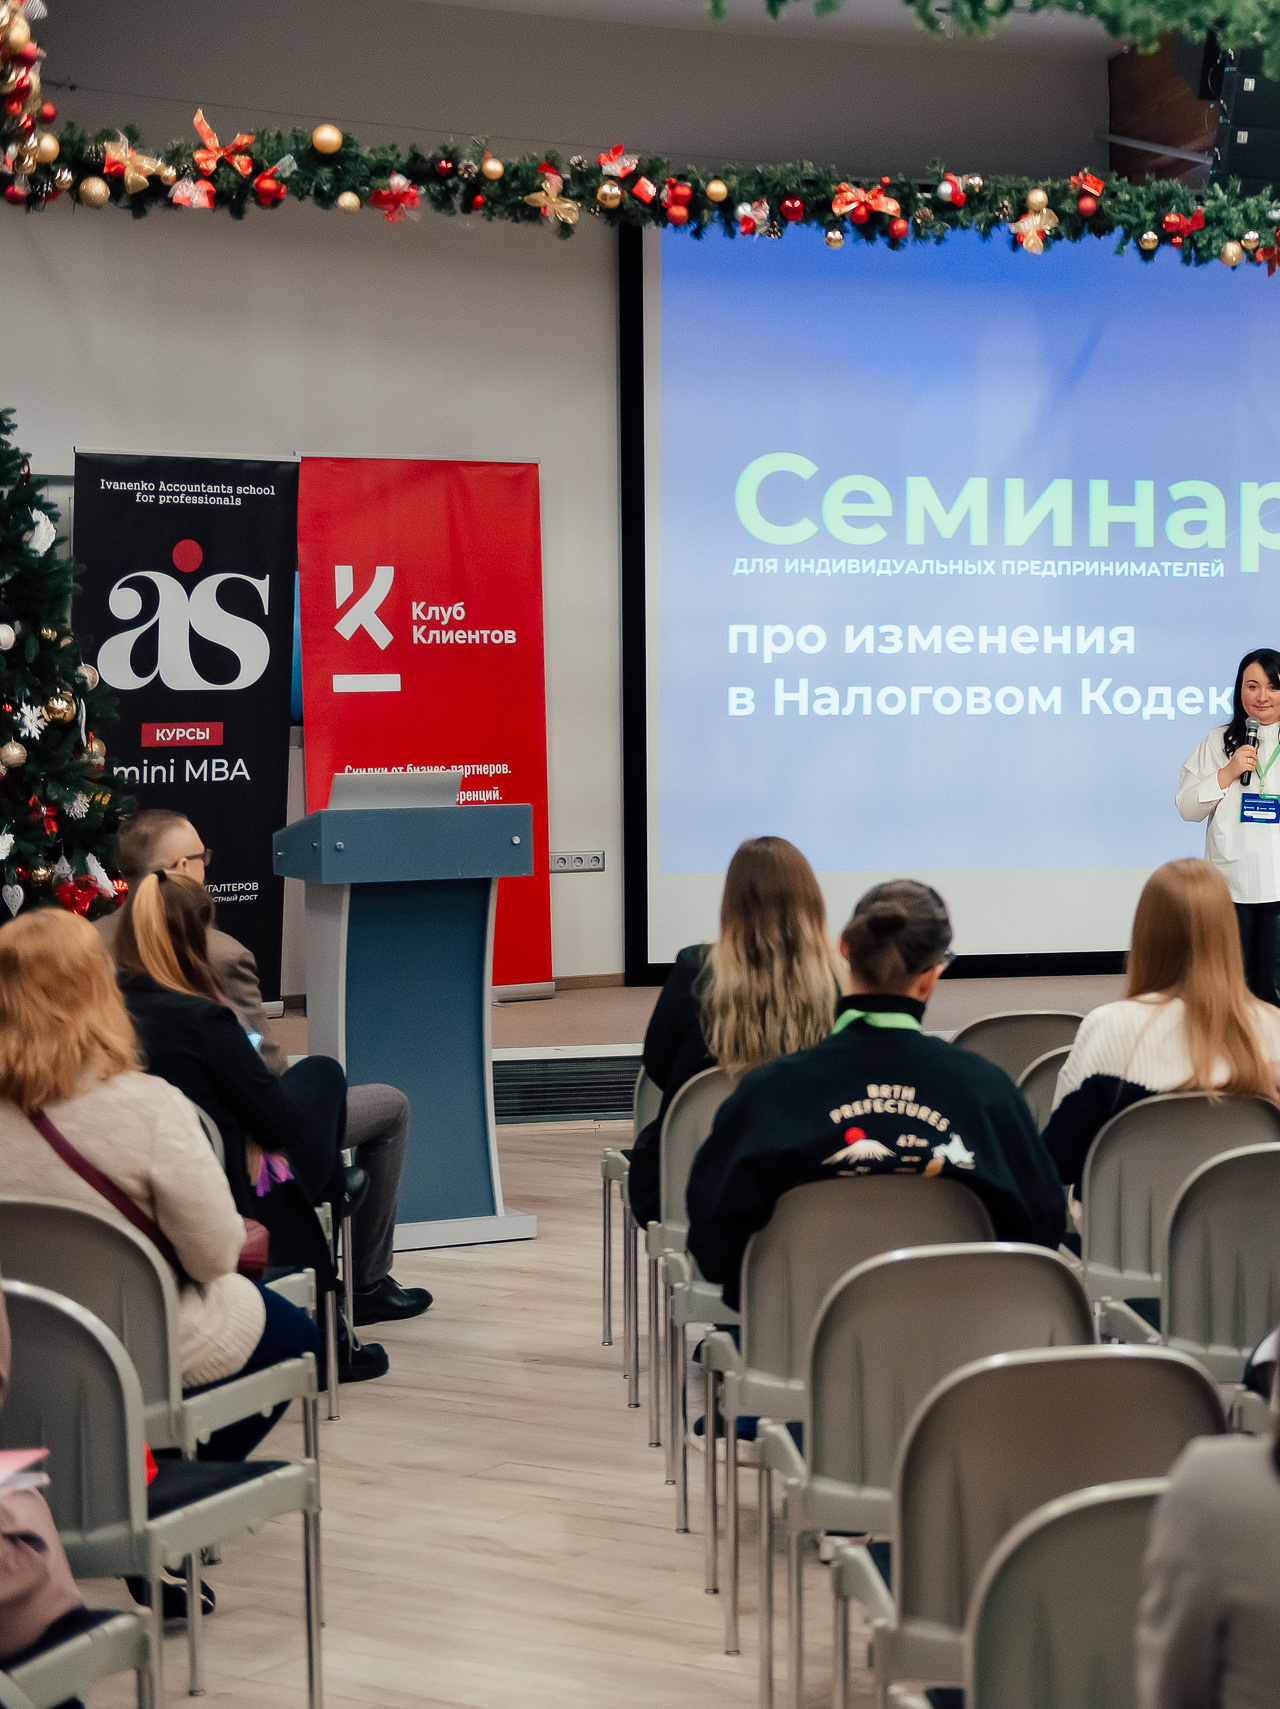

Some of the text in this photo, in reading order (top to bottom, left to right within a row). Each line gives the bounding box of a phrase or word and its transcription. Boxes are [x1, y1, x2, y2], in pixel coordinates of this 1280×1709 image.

[100, 479, 275, 496] Ivanenko Accountants school
[136, 492, 242, 506] for professionals
[732, 557, 1225, 578] ДЛЯ ИНДИВИДУАЛЬНЫХ ПРЕДПРИНИМАТЕЛЕЙ
[411, 601, 466, 625] Клуб
[412, 625, 517, 645] Клиентов
[727, 624, 1136, 664] про изменения
[727, 678, 1235, 720] в Налоговом Кодек
[156, 728, 210, 741] КУРСЫ
[112, 758, 251, 784] mini MBA
[239, 894, 259, 902] рост
